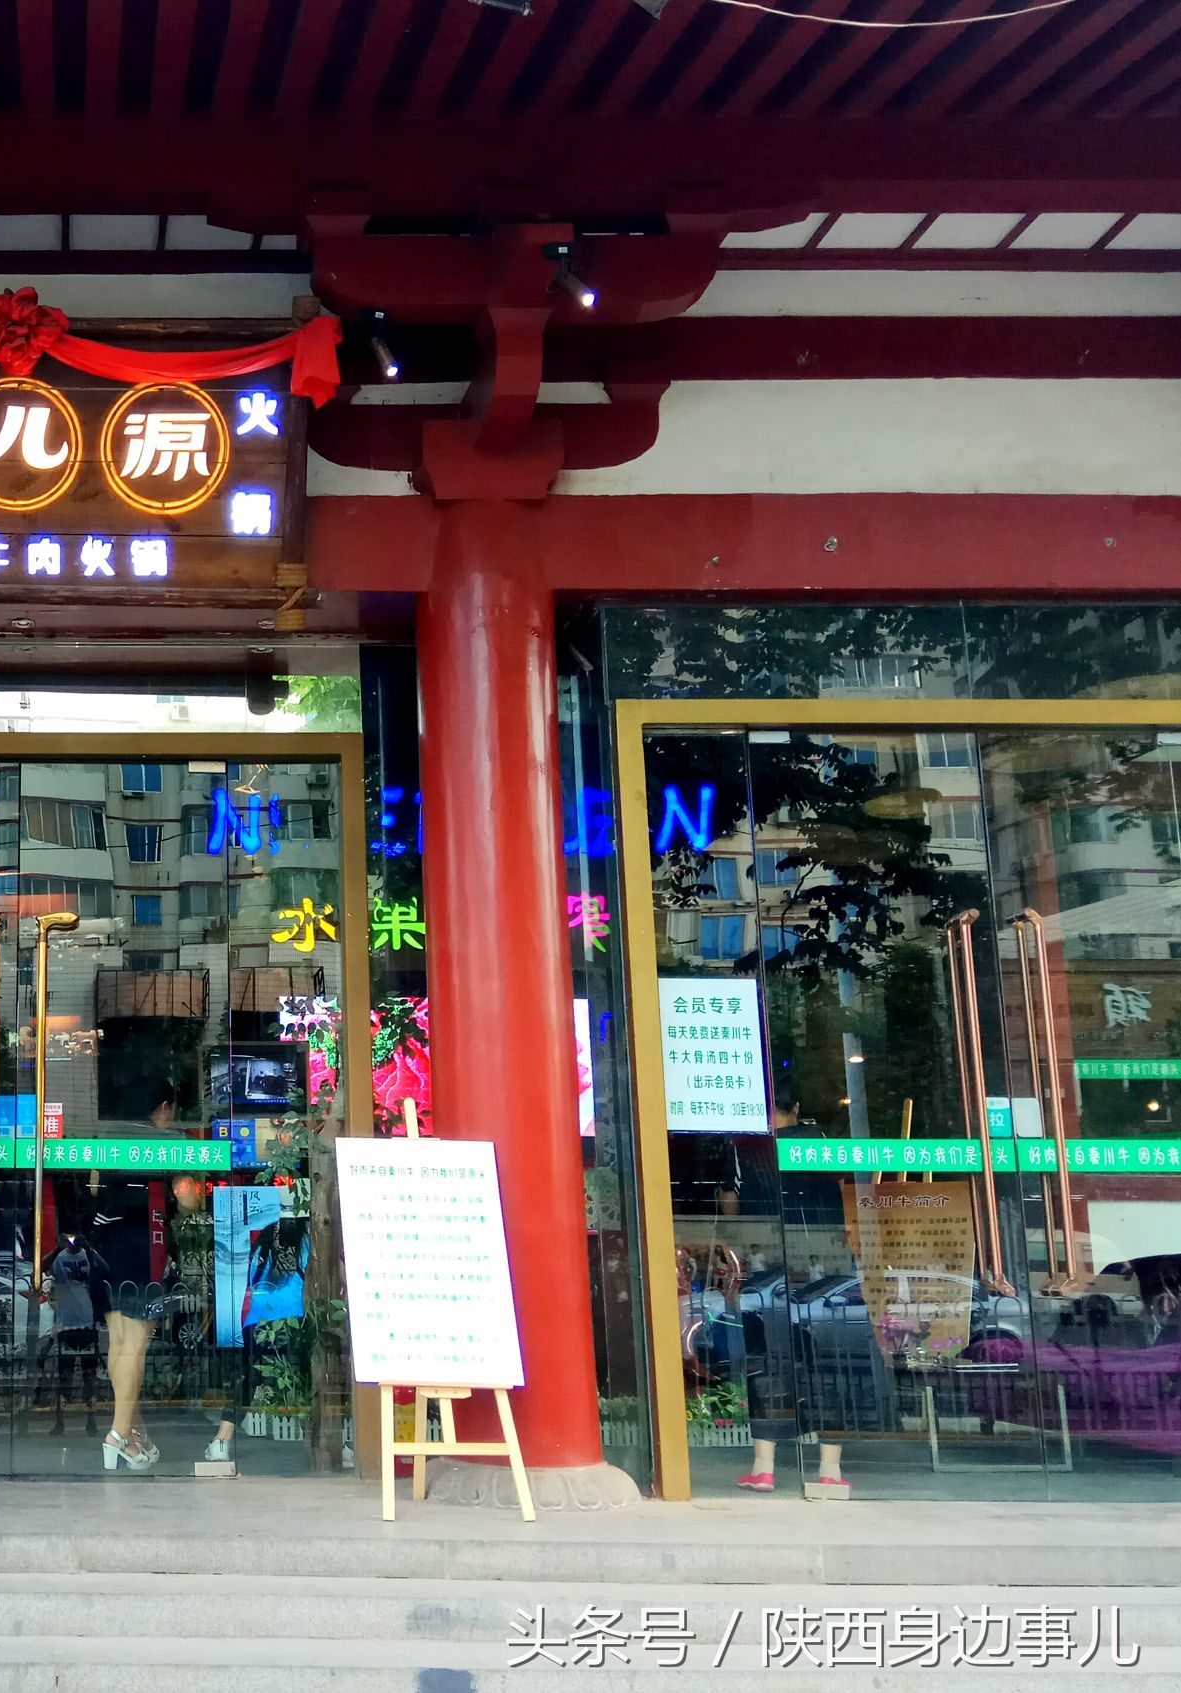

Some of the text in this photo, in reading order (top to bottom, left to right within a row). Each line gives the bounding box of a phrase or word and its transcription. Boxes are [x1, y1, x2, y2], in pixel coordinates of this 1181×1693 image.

[231, 390, 280, 537] 火锅
[673, 996, 742, 1014] 会员专享
[667, 1026, 752, 1040] 每天免费送秦川牛
[668, 1050, 754, 1065] 牛大骨汤四十份
[989, 1112, 1005, 1127] 拉
[129, 1145, 224, 1164] 因为我们是源头
[789, 1145, 1008, 1165] 好肉来自秦川牛 因为我们是头
